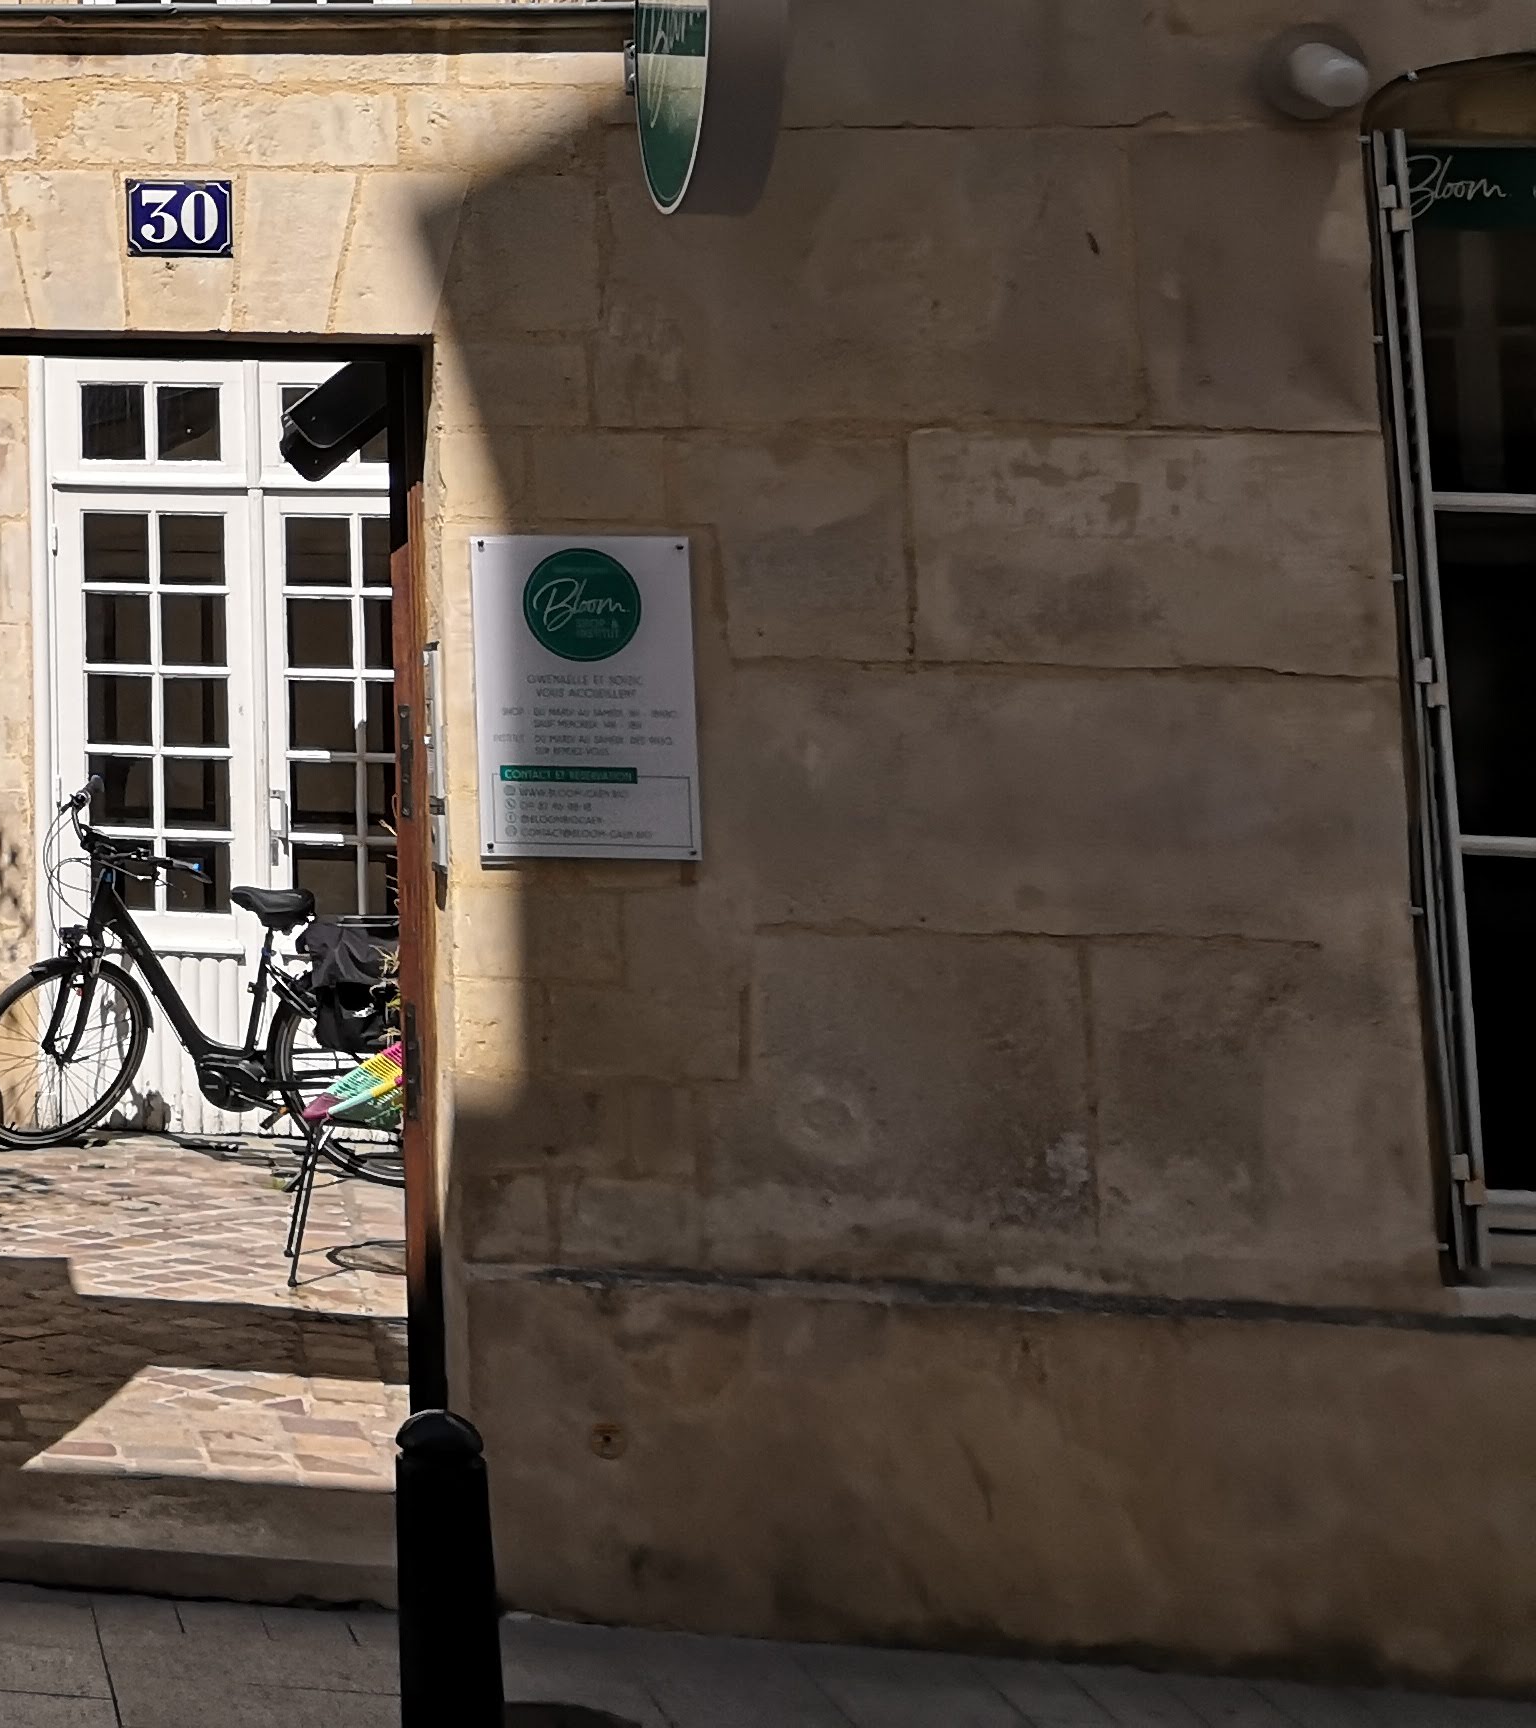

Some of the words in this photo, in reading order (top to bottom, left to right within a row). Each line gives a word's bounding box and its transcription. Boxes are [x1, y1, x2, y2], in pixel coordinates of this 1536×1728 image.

[140, 189, 218, 244] 30
[532, 577, 630, 632] Bloom
[504, 769, 551, 780] CONTACT
